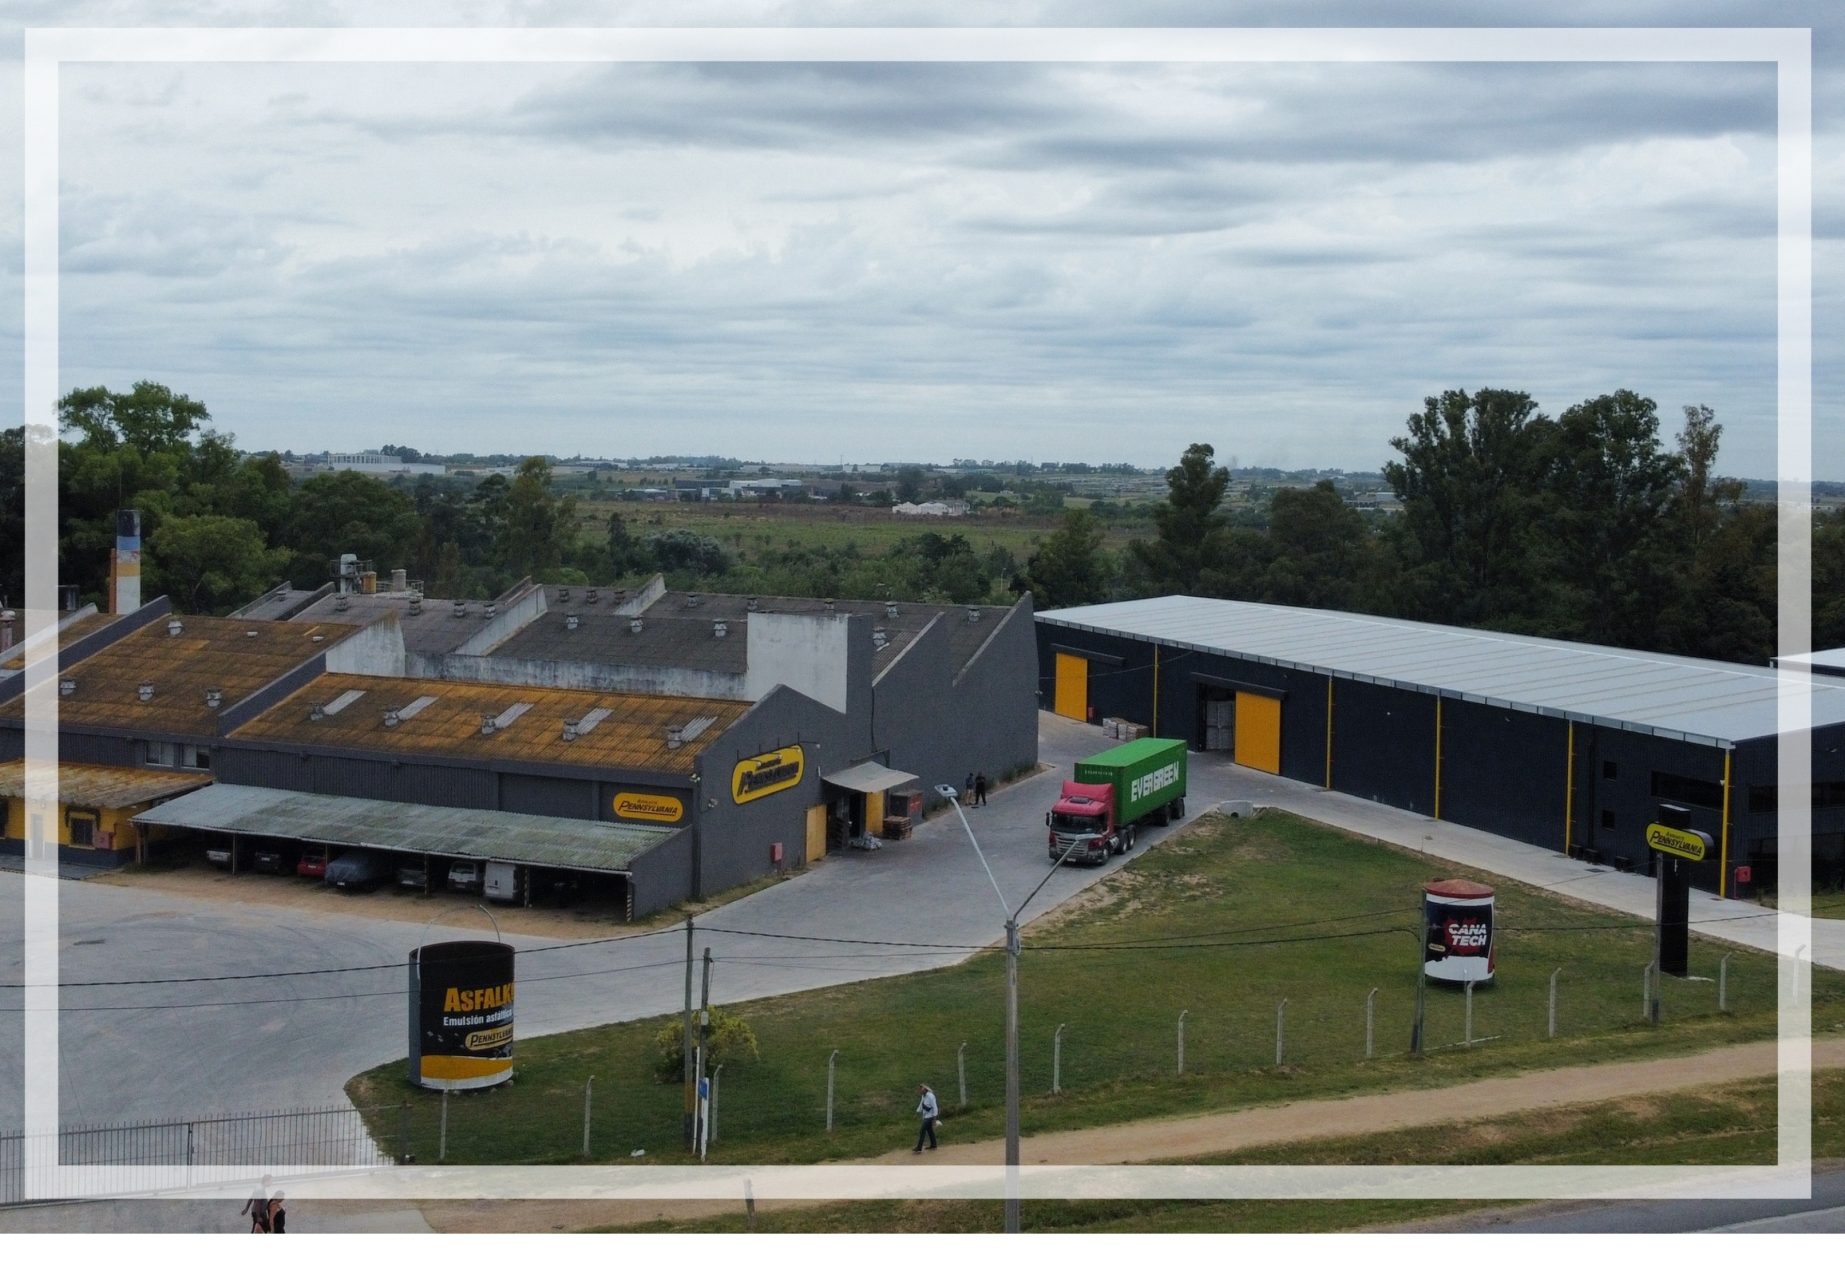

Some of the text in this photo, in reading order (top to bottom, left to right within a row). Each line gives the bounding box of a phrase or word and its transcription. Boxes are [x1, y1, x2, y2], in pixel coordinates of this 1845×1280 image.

[1131, 761, 1180, 802] EVERGREEN
[1448, 923, 1487, 935] CANA
[1452, 934, 1488, 946] TECH
[443, 1014, 484, 1027] Emulsión
